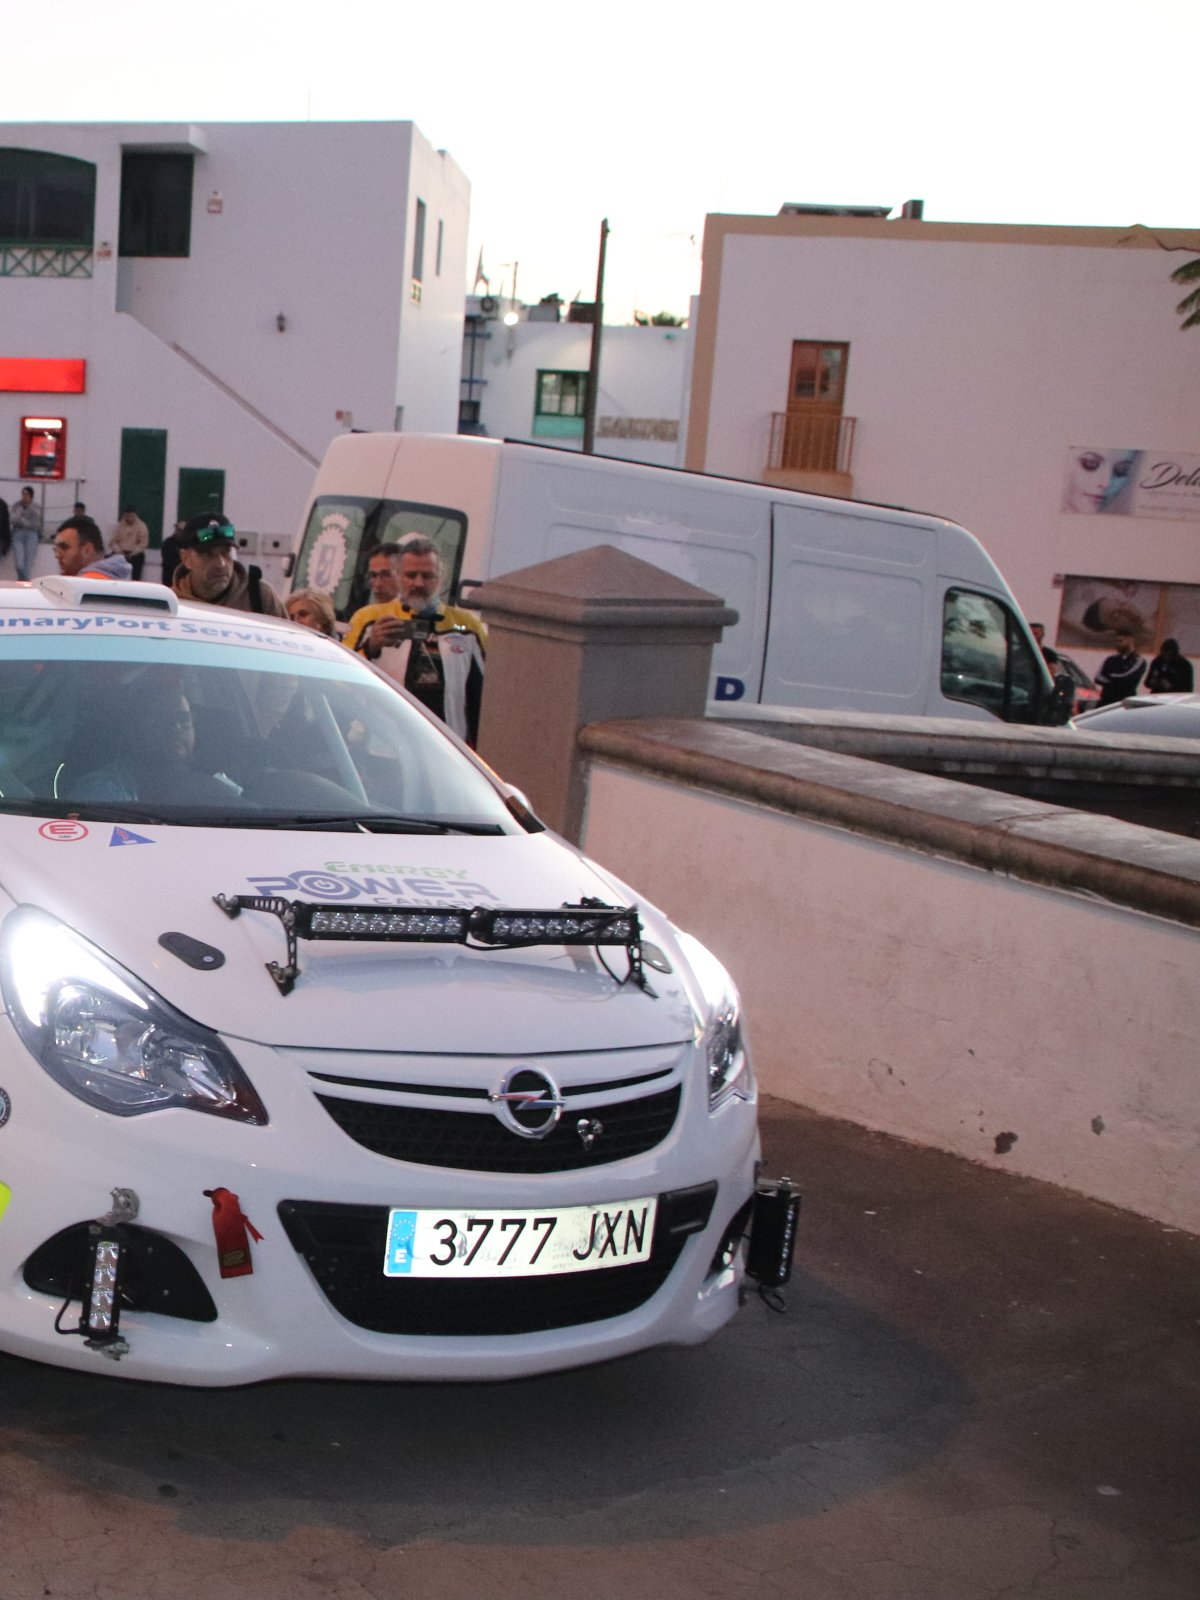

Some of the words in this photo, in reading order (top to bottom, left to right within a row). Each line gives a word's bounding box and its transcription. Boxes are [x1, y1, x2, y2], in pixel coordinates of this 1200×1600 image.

[181, 621, 315, 652] Services
[246, 870, 502, 901] POWER
[324, 861, 468, 881] ENERGY
[430, 1216, 558, 1266] 3777
[573, 1207, 648, 1261] JXN
[394, 1248, 408, 1263] E
